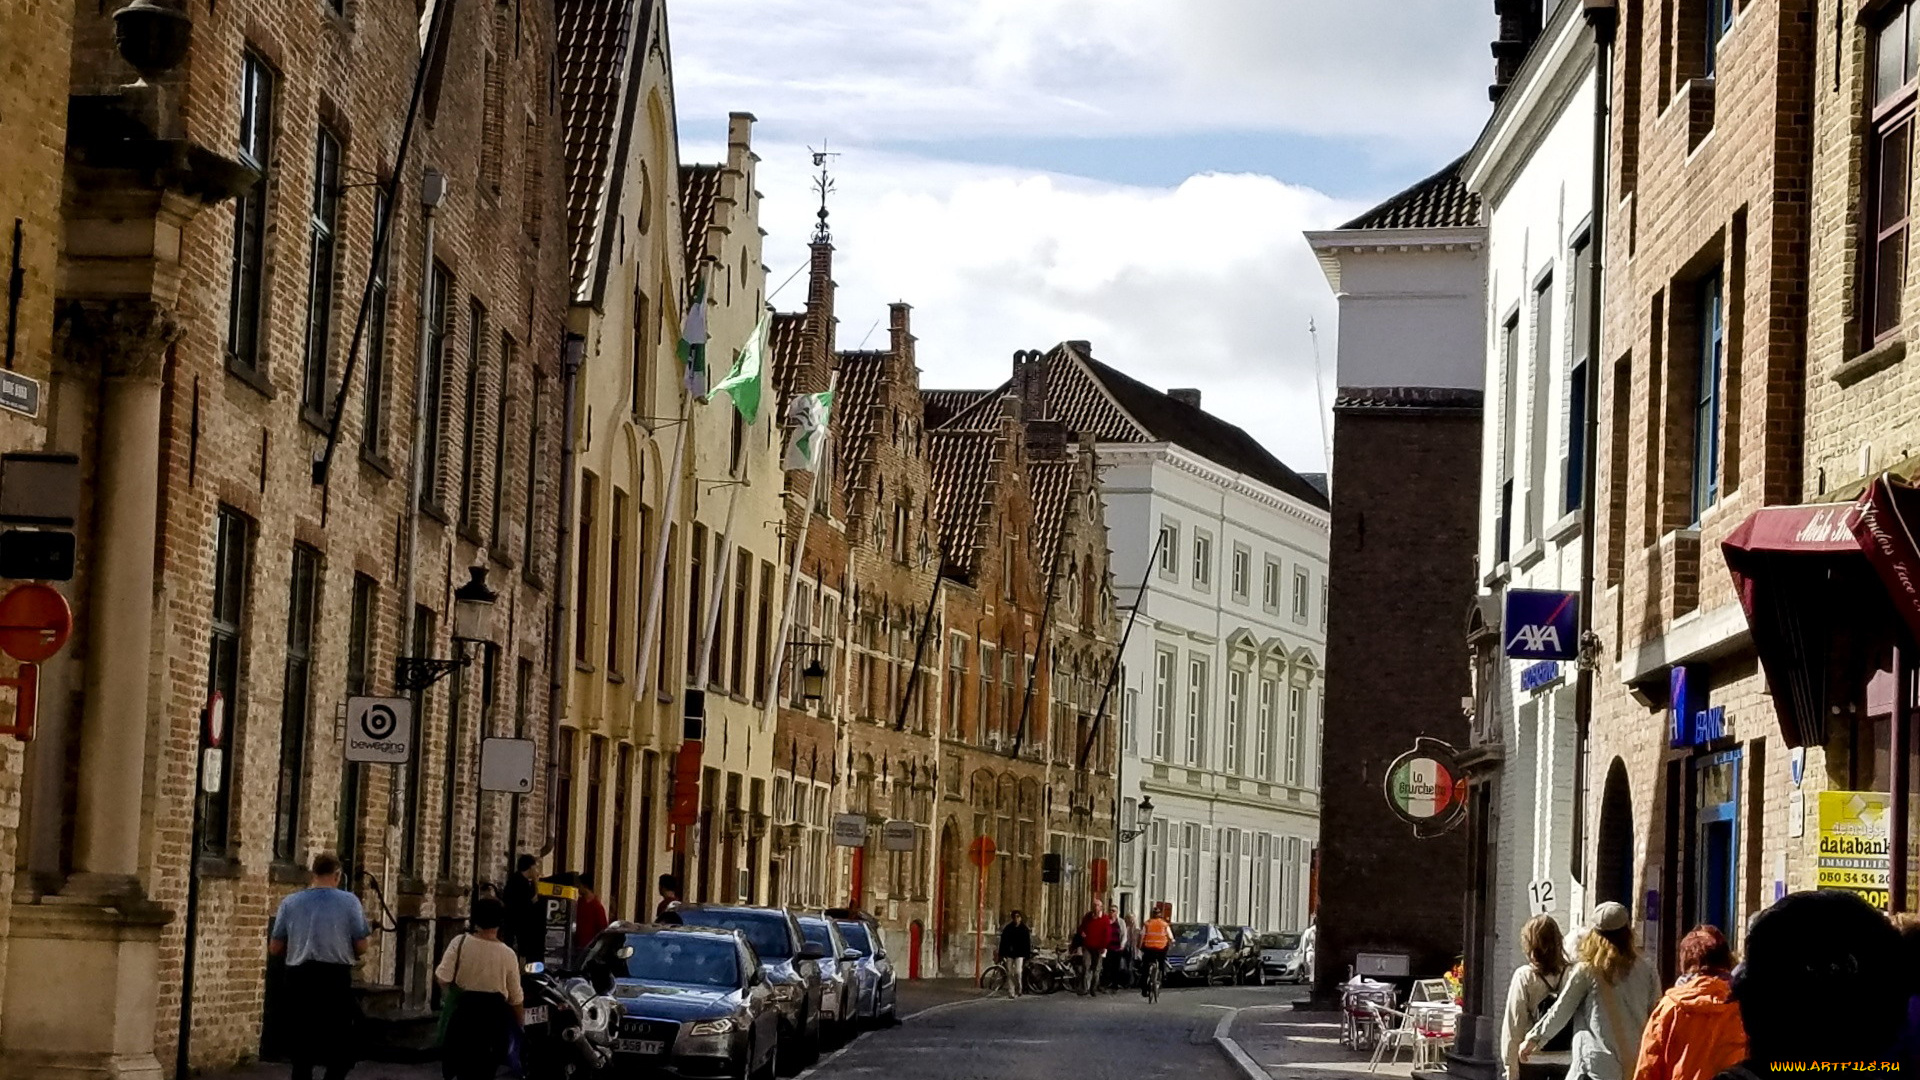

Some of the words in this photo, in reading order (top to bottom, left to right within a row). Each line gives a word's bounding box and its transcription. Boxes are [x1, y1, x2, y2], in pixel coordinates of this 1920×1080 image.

[1506, 624, 1562, 652] AXA
[351, 739, 405, 753] beweging
[1819, 872, 1841, 882] 050
[1844, 873, 1858, 883] 34
[1861, 873, 1875, 884] 34
[1531, 881, 1553, 903] 12
